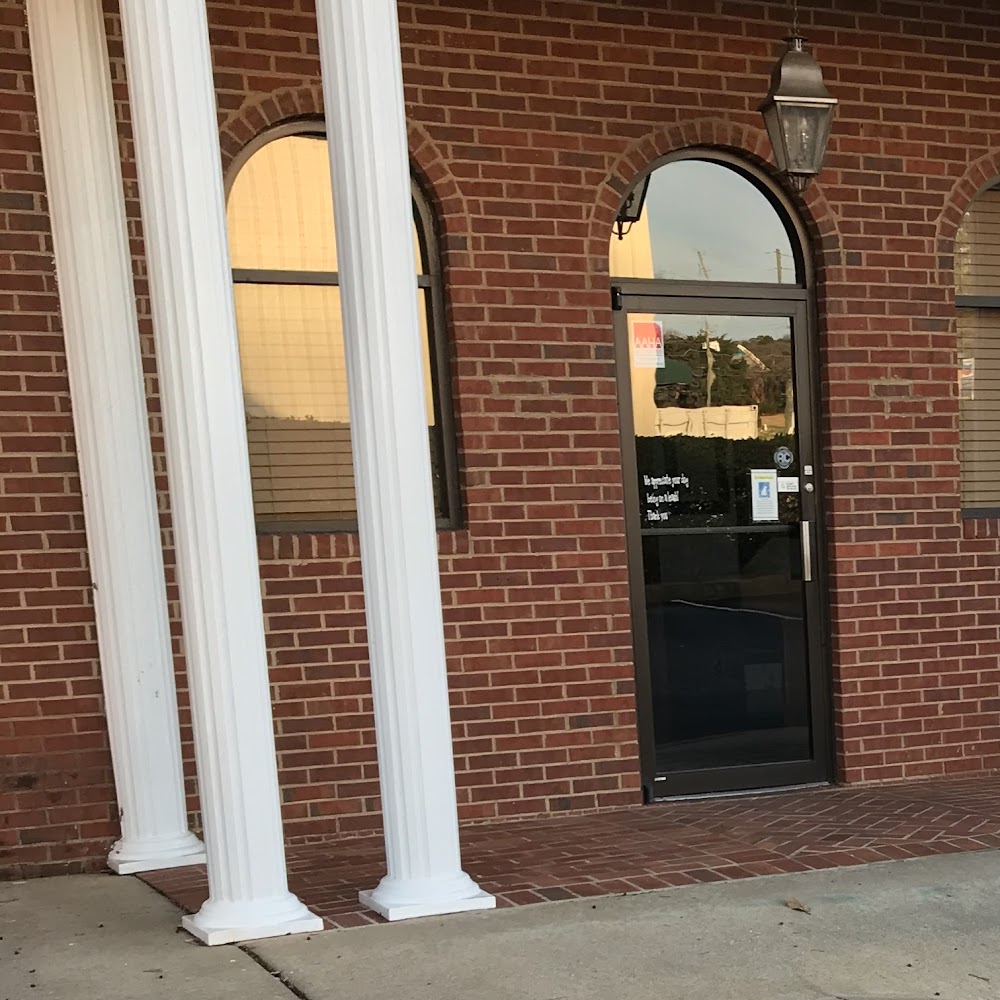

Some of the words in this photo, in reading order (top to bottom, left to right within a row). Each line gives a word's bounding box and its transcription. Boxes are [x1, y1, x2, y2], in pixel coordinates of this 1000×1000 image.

[634, 336, 662, 348] AAHA
[671, 476, 680, 488] your
[680, 473, 690, 488] dog
[646, 492, 659, 507] being
[646, 510, 660, 520] Thank
